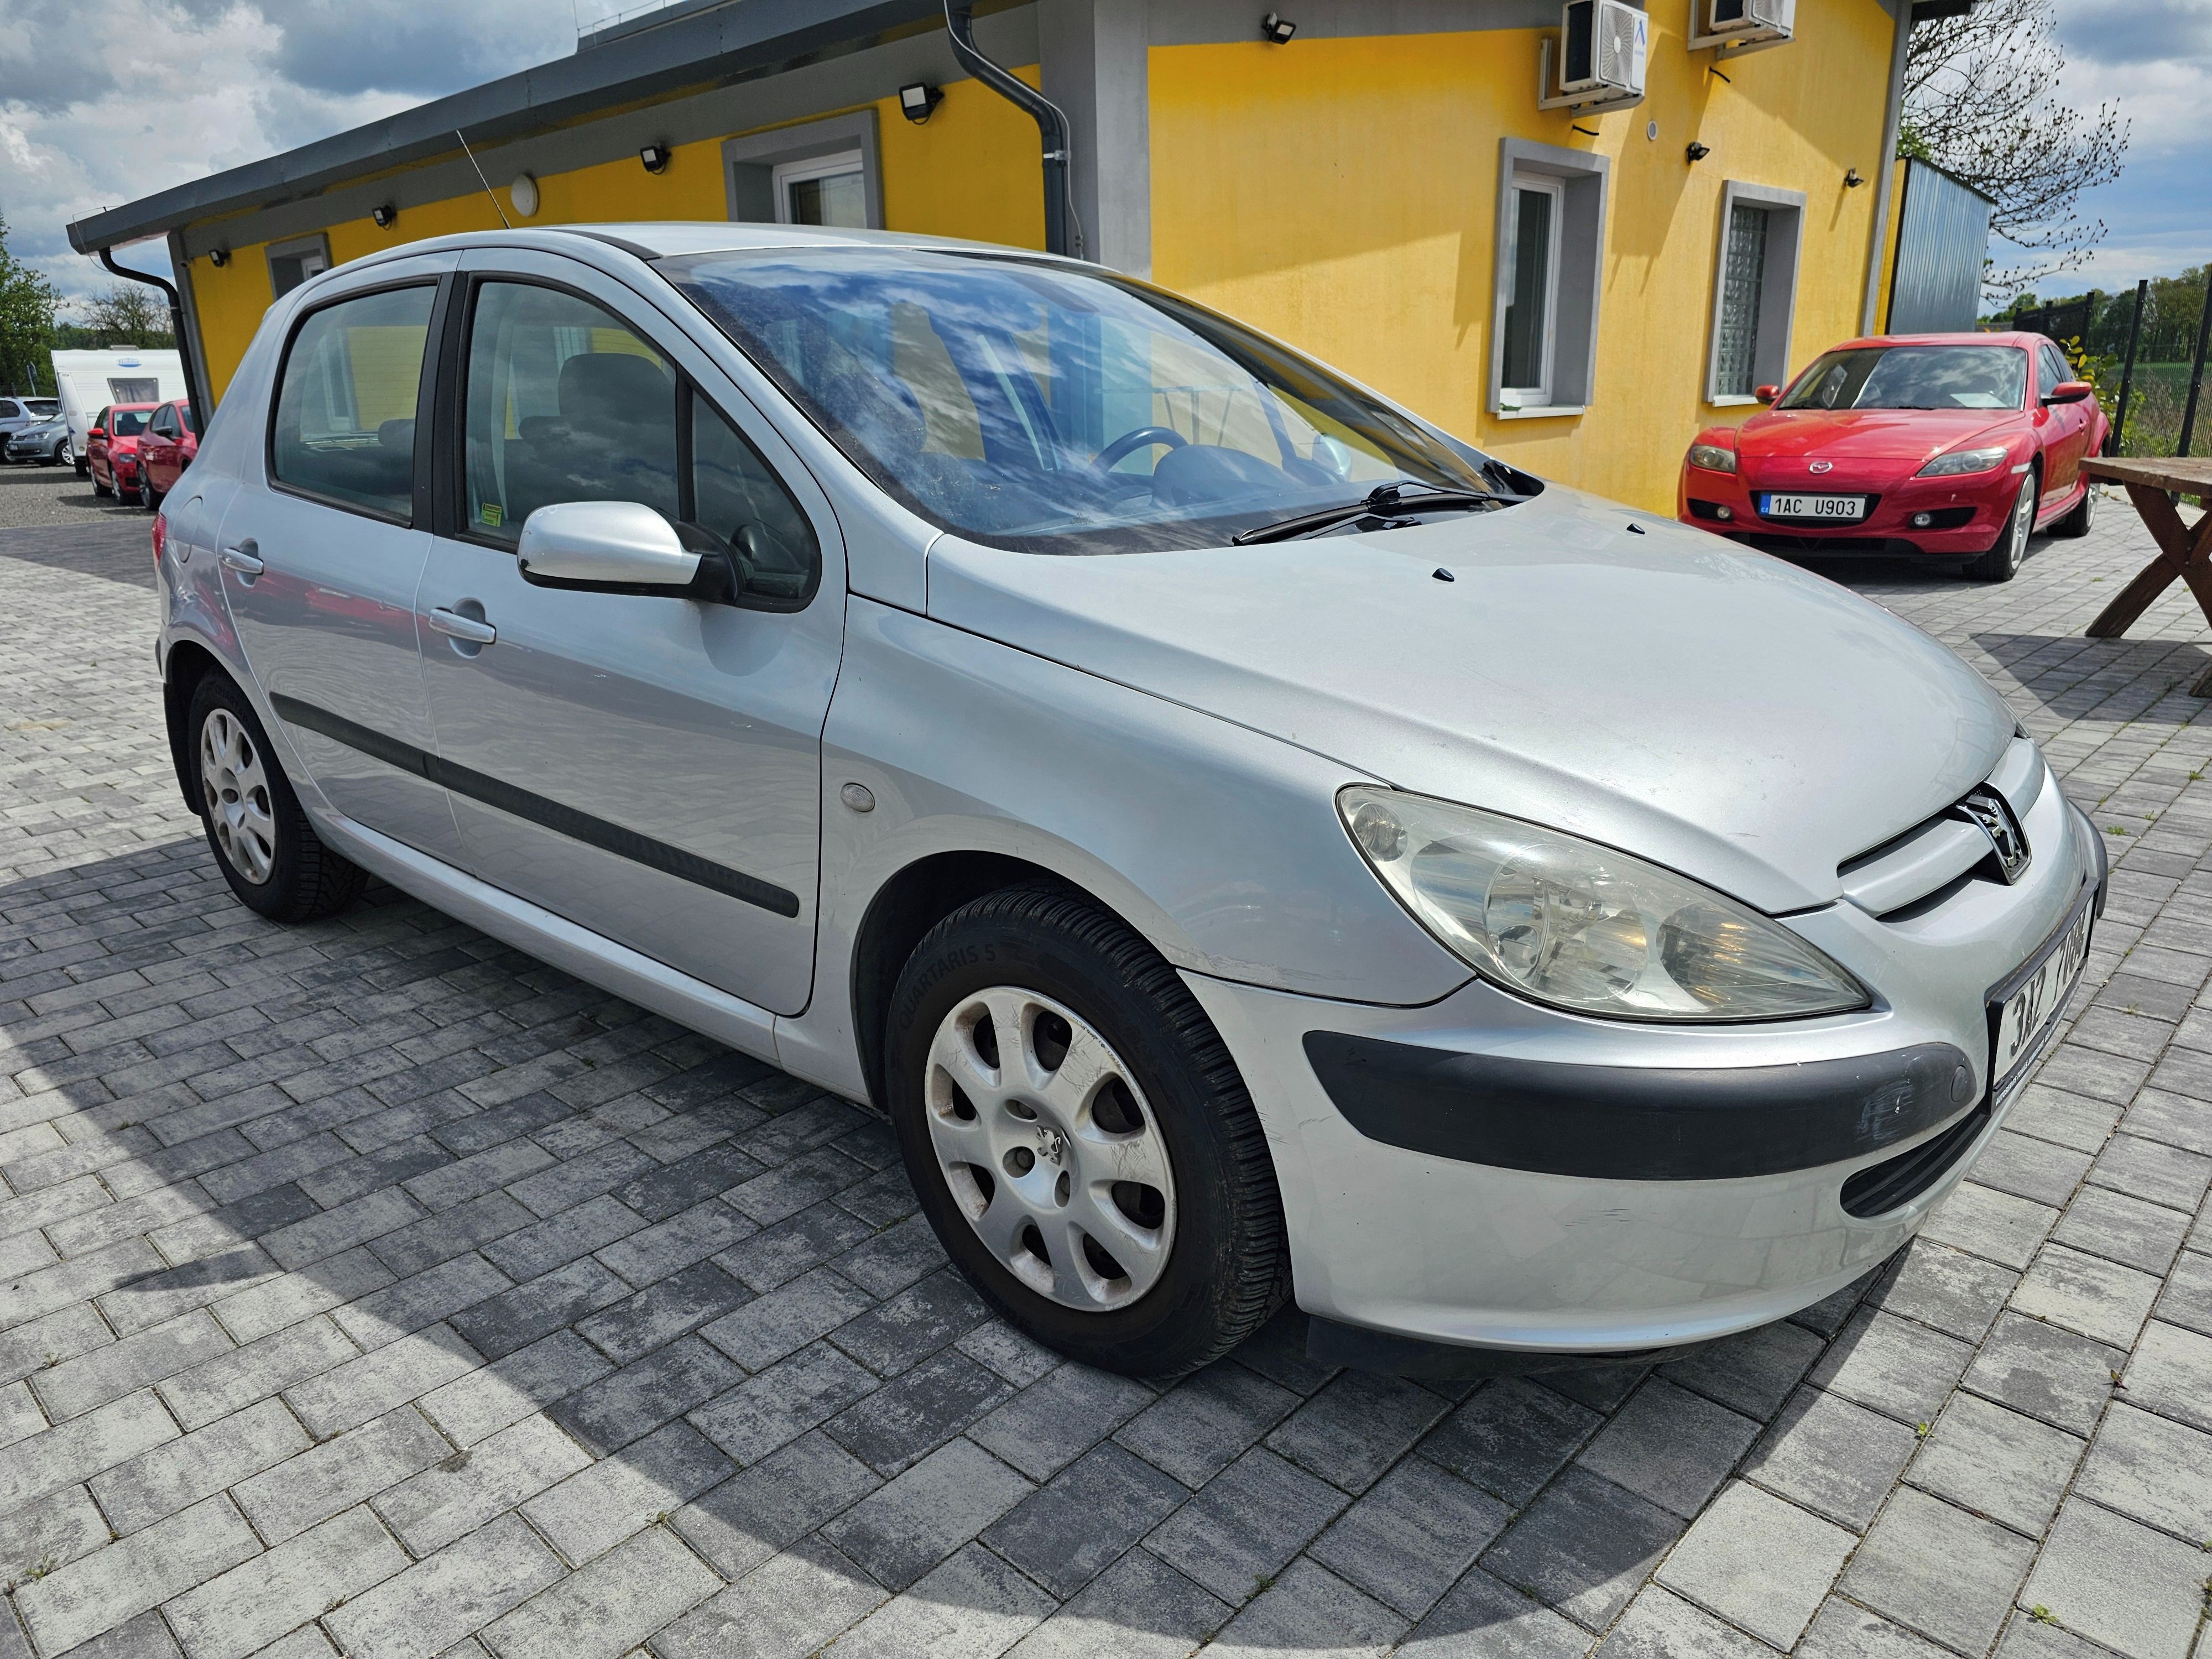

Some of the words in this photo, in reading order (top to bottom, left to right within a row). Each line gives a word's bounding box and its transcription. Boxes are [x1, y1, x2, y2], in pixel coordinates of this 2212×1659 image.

[1775, 498, 1802, 514] 1AC
[1815, 500, 1855, 515] U903
[900, 945, 979, 1030] QUARTARIS
[984, 943, 996, 962] 5
